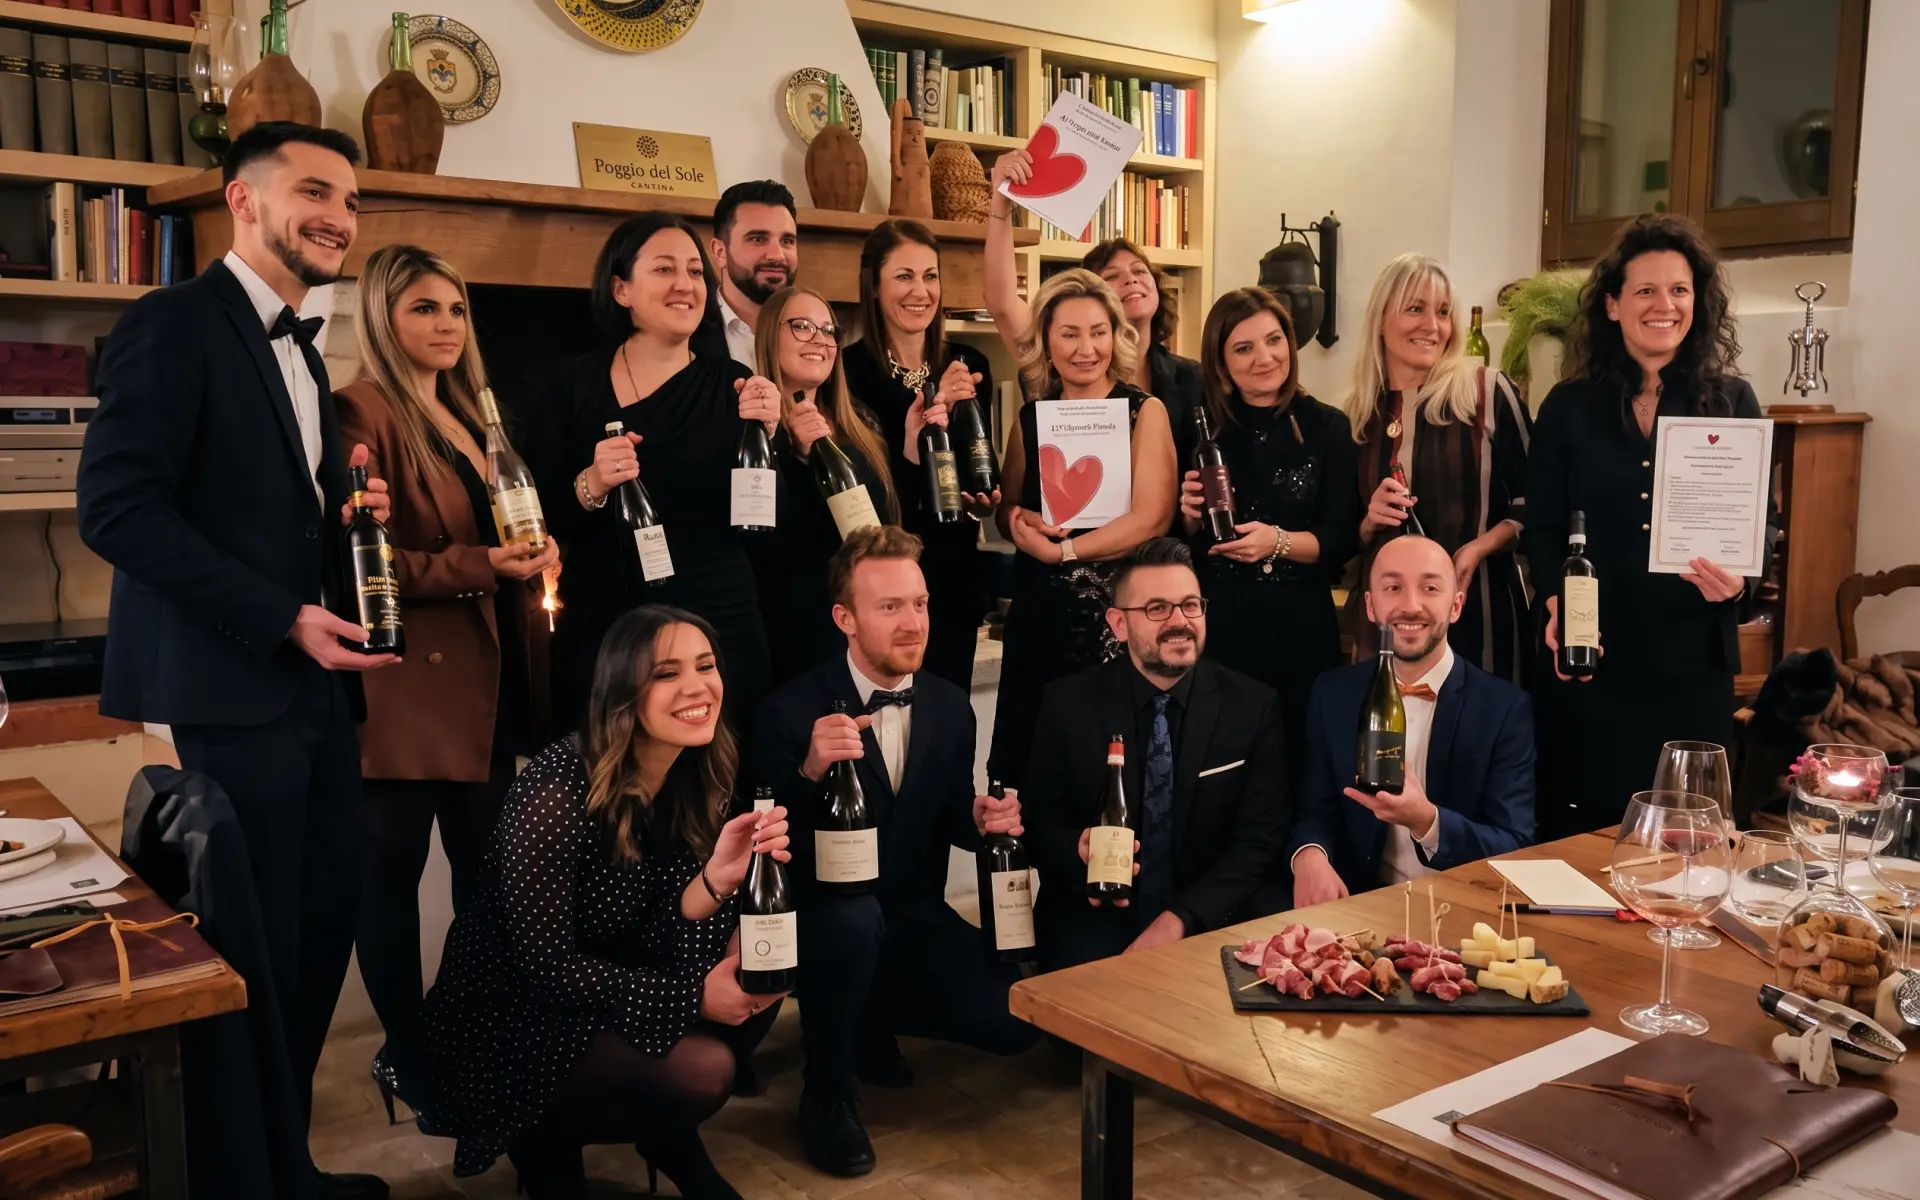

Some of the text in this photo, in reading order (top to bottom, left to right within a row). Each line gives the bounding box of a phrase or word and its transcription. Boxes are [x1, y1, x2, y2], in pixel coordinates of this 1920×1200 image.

[593, 158, 705, 183] Poggio del Sole
[631, 182, 675, 192] CANTINA
